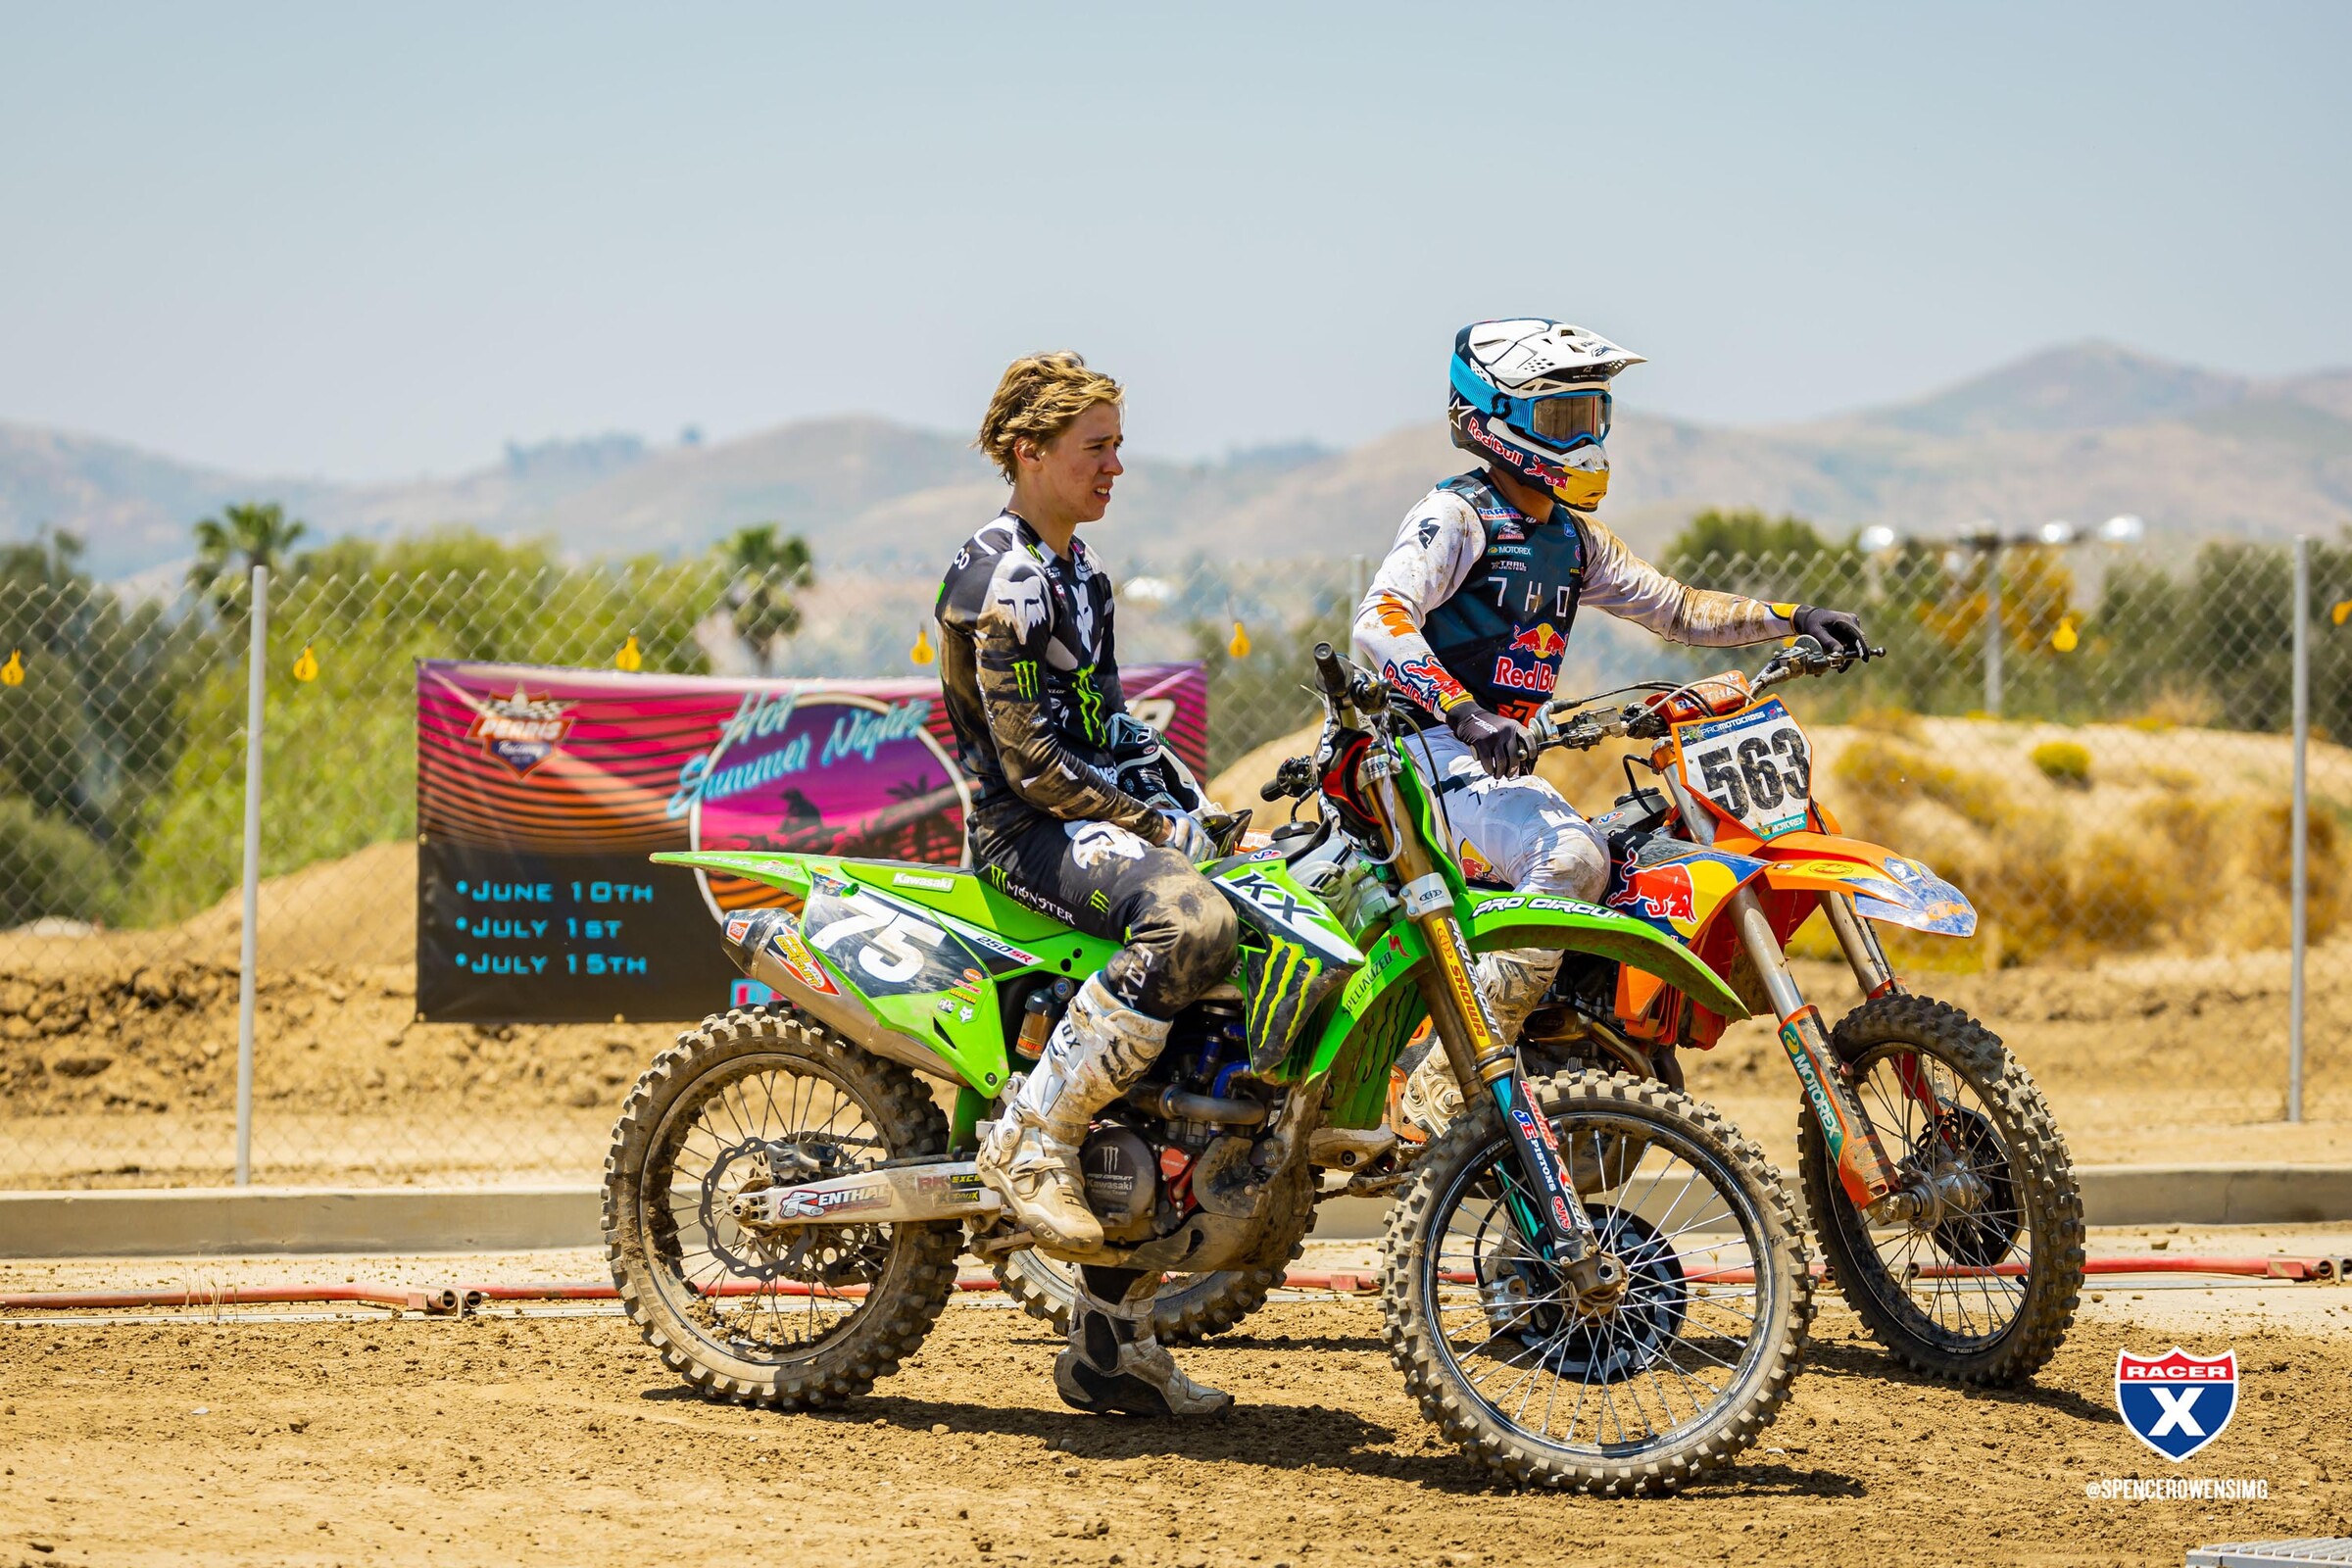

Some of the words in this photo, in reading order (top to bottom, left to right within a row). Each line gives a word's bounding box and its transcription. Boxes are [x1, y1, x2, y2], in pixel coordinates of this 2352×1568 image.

[1468, 416, 1494, 448] Red
[1491, 438, 1524, 466] Bull
[1498, 545, 1531, 555] MOTOREX
[1493, 656, 1541, 692] Red
[719, 683, 819, 749] Hot
[1471, 713, 1499, 734] THOR
[665, 731, 811, 818] Summer
[819, 698, 933, 767] Nights
[1697, 727, 1811, 822] 563
[1771, 815, 1806, 834] MOTOREX
[471, 880, 554, 903] JUNE
[571, 880, 655, 904] 10TH
[893, 872, 955, 890] Kawasaki
[1006, 880, 1075, 925] MONSTER
[1228, 872, 1323, 926] KX
[471, 916, 549, 939] JULY
[566, 916, 624, 939] 1ST
[1470, 897, 1527, 919] PRO
[774, 935, 821, 987] CIRCUIT
[783, 934, 812, 964] PRO
[808, 894, 948, 983] 75
[470, 953, 549, 975] JULY
[566, 953, 648, 975] 15TH
[1342, 952, 1394, 1020] SPECIALIZED
[1446, 917, 1473, 959] PRO
[1464, 959, 1503, 1040] CIRCUIT
[1449, 963, 1487, 1038] SHOWA
[1520, 1080, 1559, 1151] BRAKING
[1793, 1053, 1841, 1139] MOTOREX
[1087, 1179, 1133, 1191] Kawasaki
[1530, 1138, 1557, 1193] PISTONS
[780, 1184, 890, 1217] RENTHAL
[1552, 1195, 1572, 1230] GUTS
